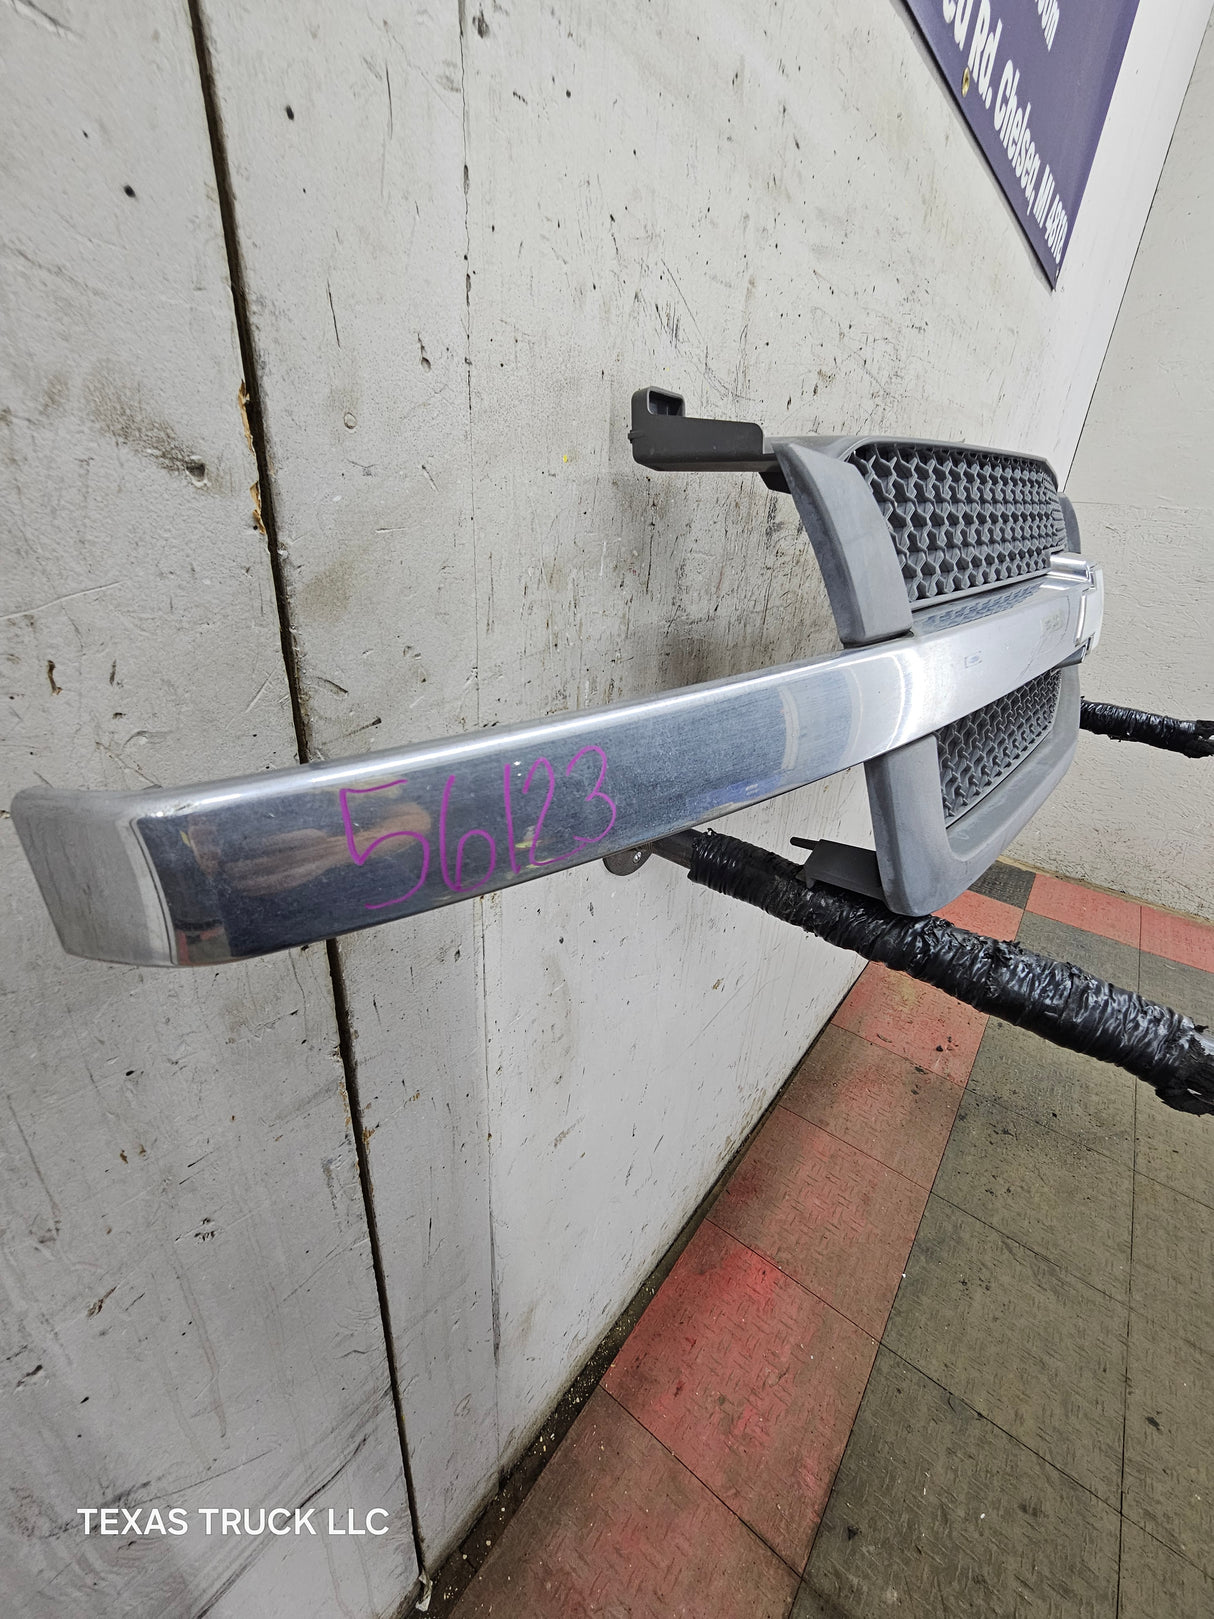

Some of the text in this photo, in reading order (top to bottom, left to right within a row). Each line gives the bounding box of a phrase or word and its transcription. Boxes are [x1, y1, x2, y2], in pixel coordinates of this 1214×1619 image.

[967, 0, 1003, 110] Rd.
[994, 59, 1041, 217] Chelsea,
[1033, 164, 1055, 229] MI
[1045, 193, 1068, 264] 48118
[339, 745, 616, 909] 56123
